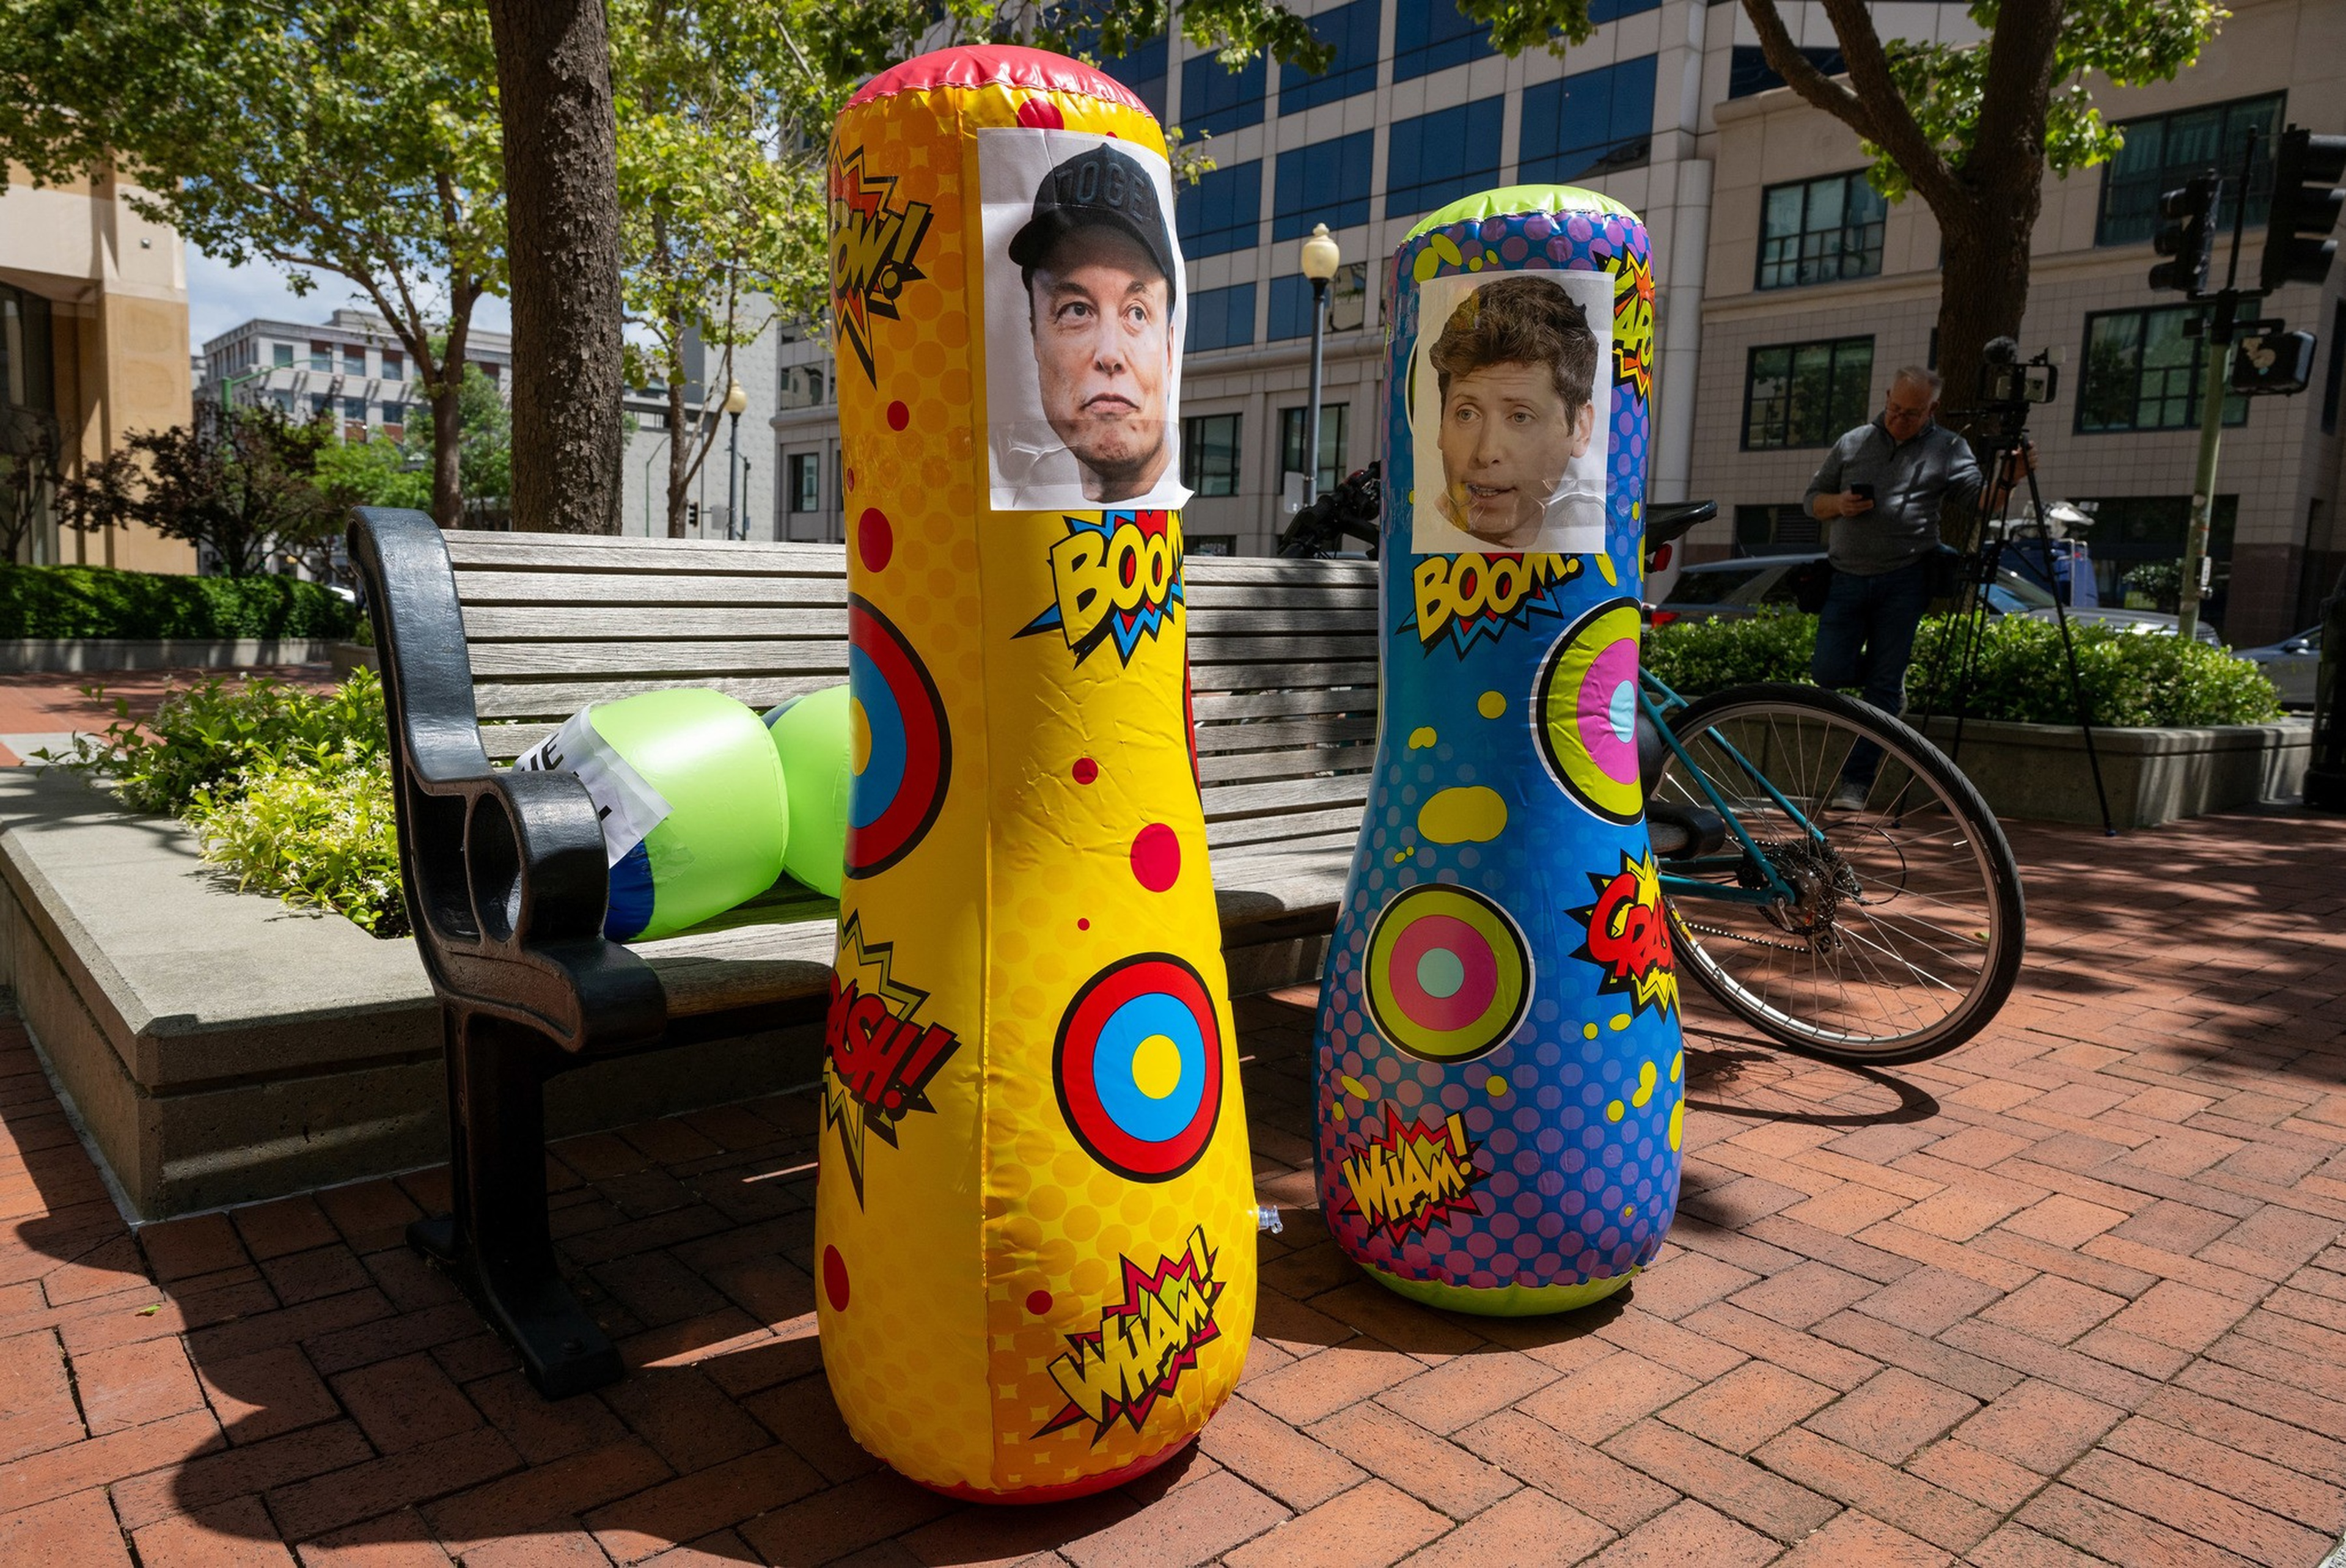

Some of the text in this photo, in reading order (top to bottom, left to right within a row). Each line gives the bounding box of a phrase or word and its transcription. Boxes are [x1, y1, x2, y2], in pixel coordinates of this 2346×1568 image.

[1588, 872, 1675, 979] CRAS
[1341, 1111, 1472, 1225] WHAM!
[1046, 1224, 1212, 1424] WHAM!
